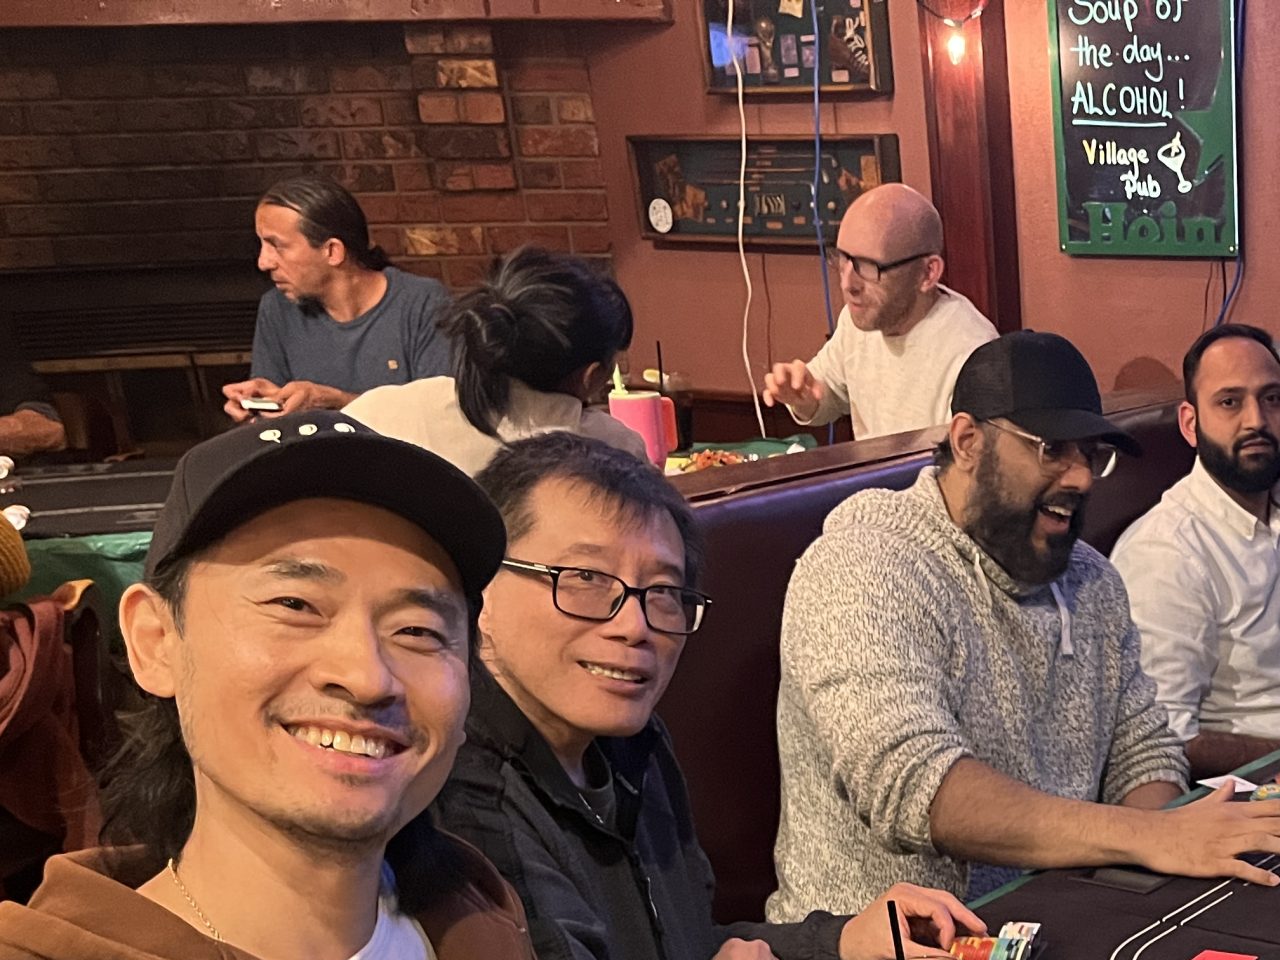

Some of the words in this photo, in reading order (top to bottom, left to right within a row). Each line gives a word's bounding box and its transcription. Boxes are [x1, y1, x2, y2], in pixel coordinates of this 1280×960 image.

[1068, 0, 1139, 32] Soup
[1070, 34, 1114, 69] the
[1082, 138, 1150, 178] Village
[1119, 170, 1161, 200] Pub
